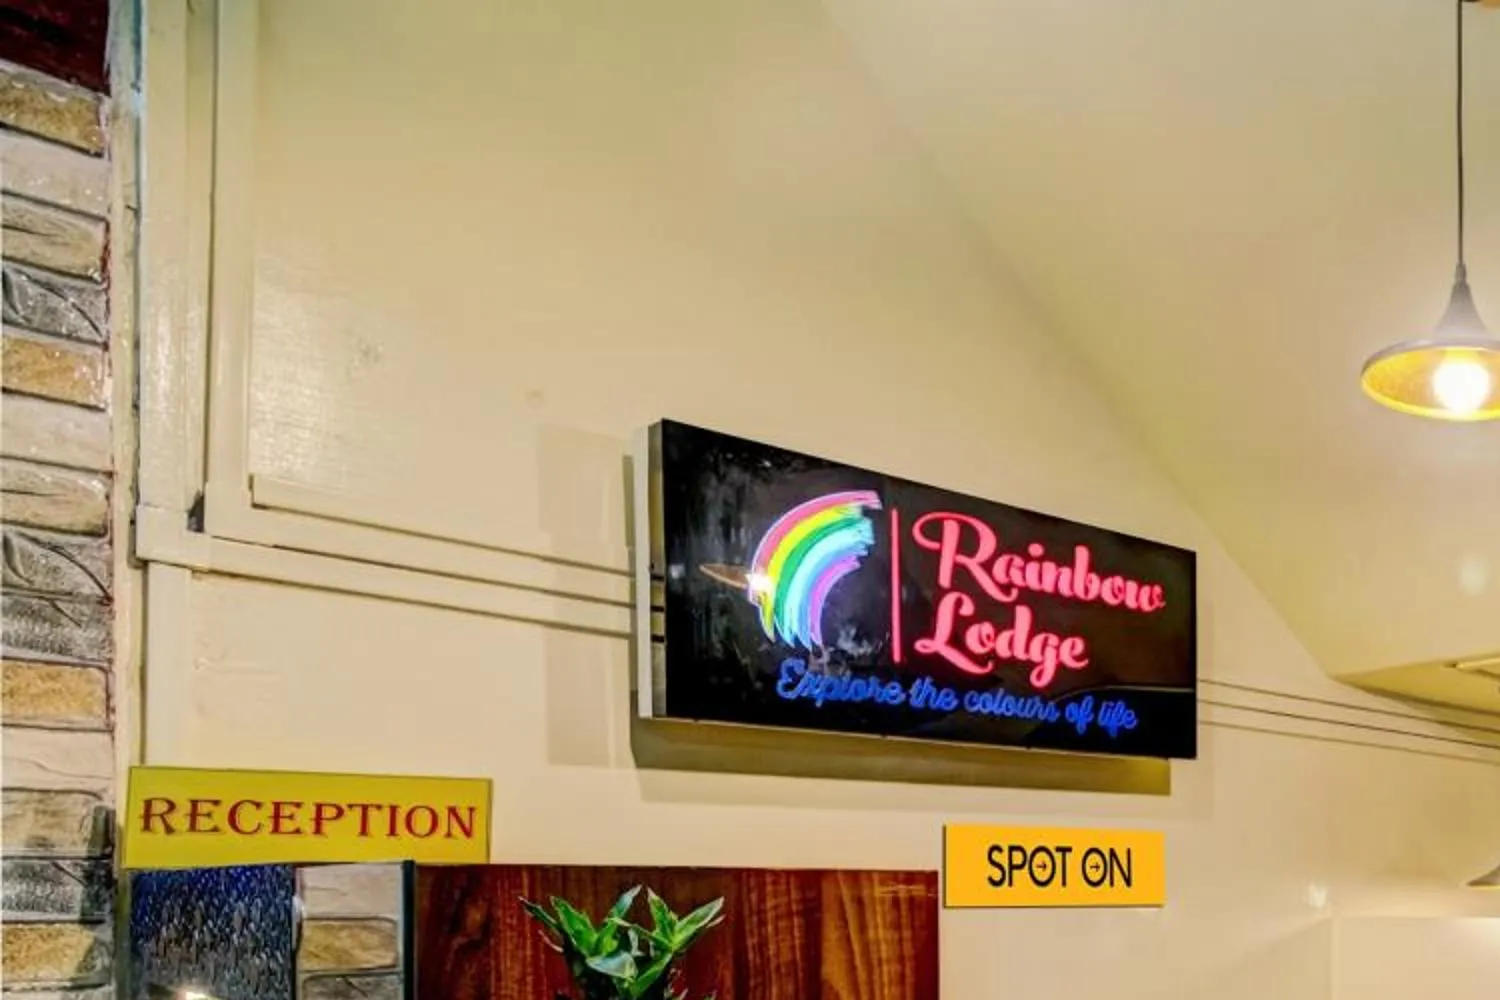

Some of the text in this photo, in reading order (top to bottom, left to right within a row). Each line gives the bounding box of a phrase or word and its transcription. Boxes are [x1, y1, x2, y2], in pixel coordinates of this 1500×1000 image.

[912, 511, 1165, 613] Rainbow
[914, 592, 1088, 687] Lodge
[776, 658, 1138, 738] Explore the colours of life
[139, 797, 476, 839] RECEPTION
[987, 844, 1132, 887] SPOT ON
